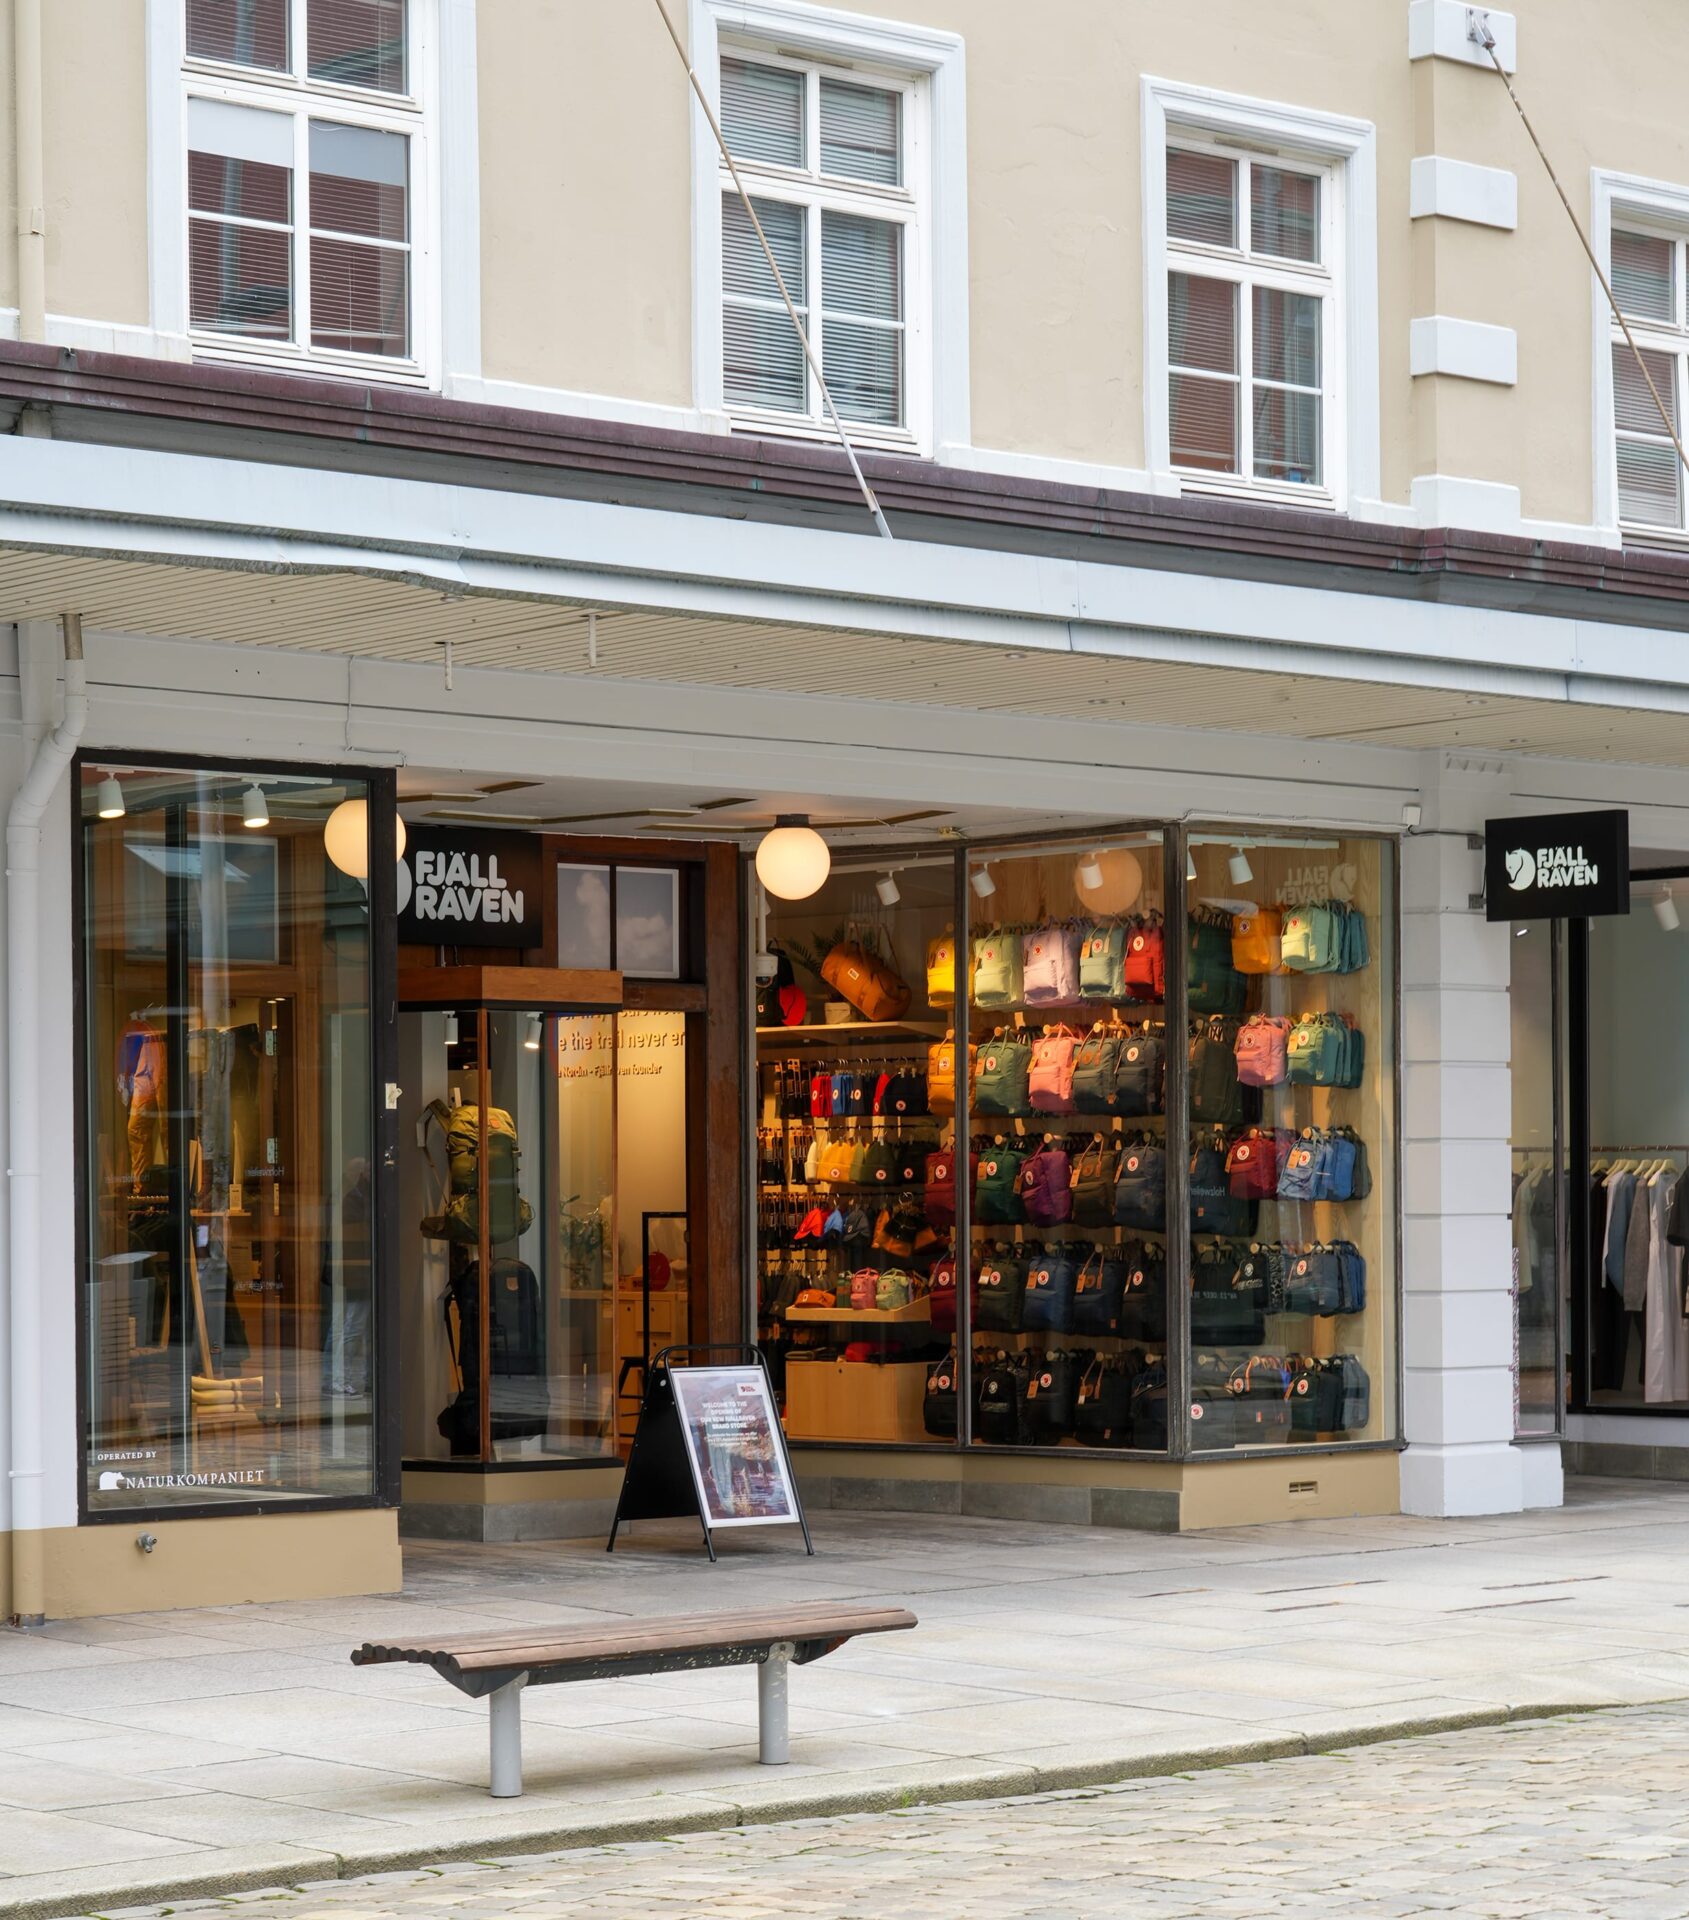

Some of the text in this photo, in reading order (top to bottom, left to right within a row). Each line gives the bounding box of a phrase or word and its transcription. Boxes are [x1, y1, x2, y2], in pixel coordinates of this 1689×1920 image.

[1537, 845, 1588, 868] FJÄLL
[416, 850, 507, 889] FJÄLL
[1537, 864, 1598, 888] RÄVEN
[416, 885, 524, 924] RÄVEN
[572, 1030, 592, 1051] the
[628, 1032, 667, 1049] never
[632, 1062, 662, 1076] founder
[97, 1451, 157, 1461] OPERATED BY
[126, 1470, 264, 1489] NATURKOMPANIET
